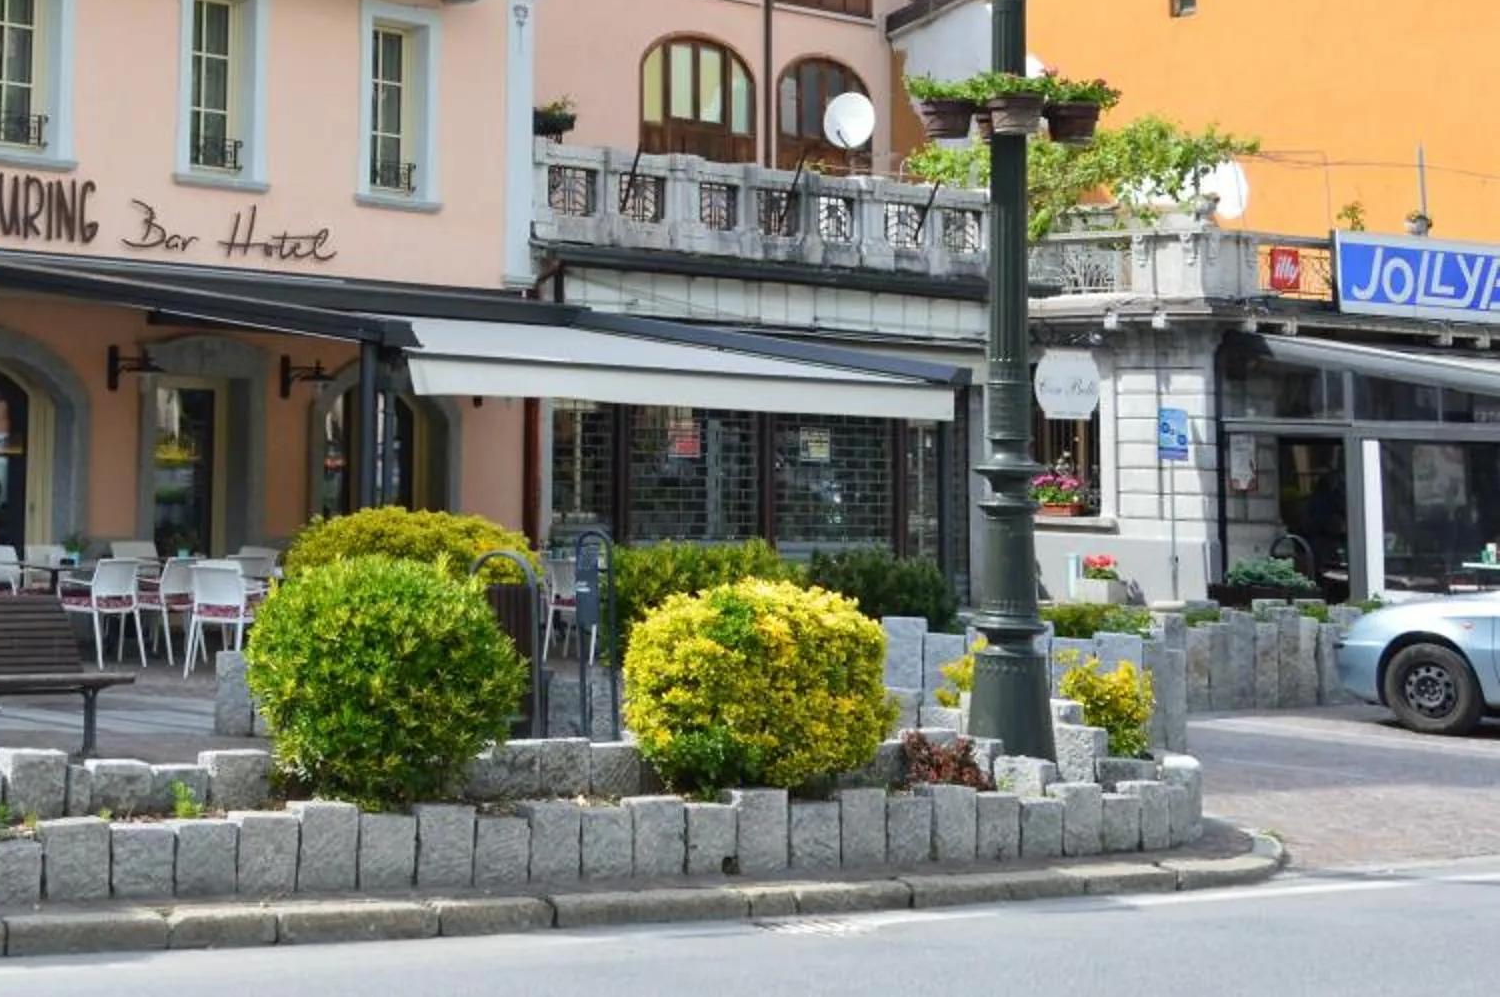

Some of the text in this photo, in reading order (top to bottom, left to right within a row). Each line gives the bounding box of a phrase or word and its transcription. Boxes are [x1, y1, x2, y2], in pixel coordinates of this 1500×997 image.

[121, 199, 338, 262] Bar Hotel
[1274, 254, 1299, 286] illy
[1352, 247, 1500, 309] JOLLY
